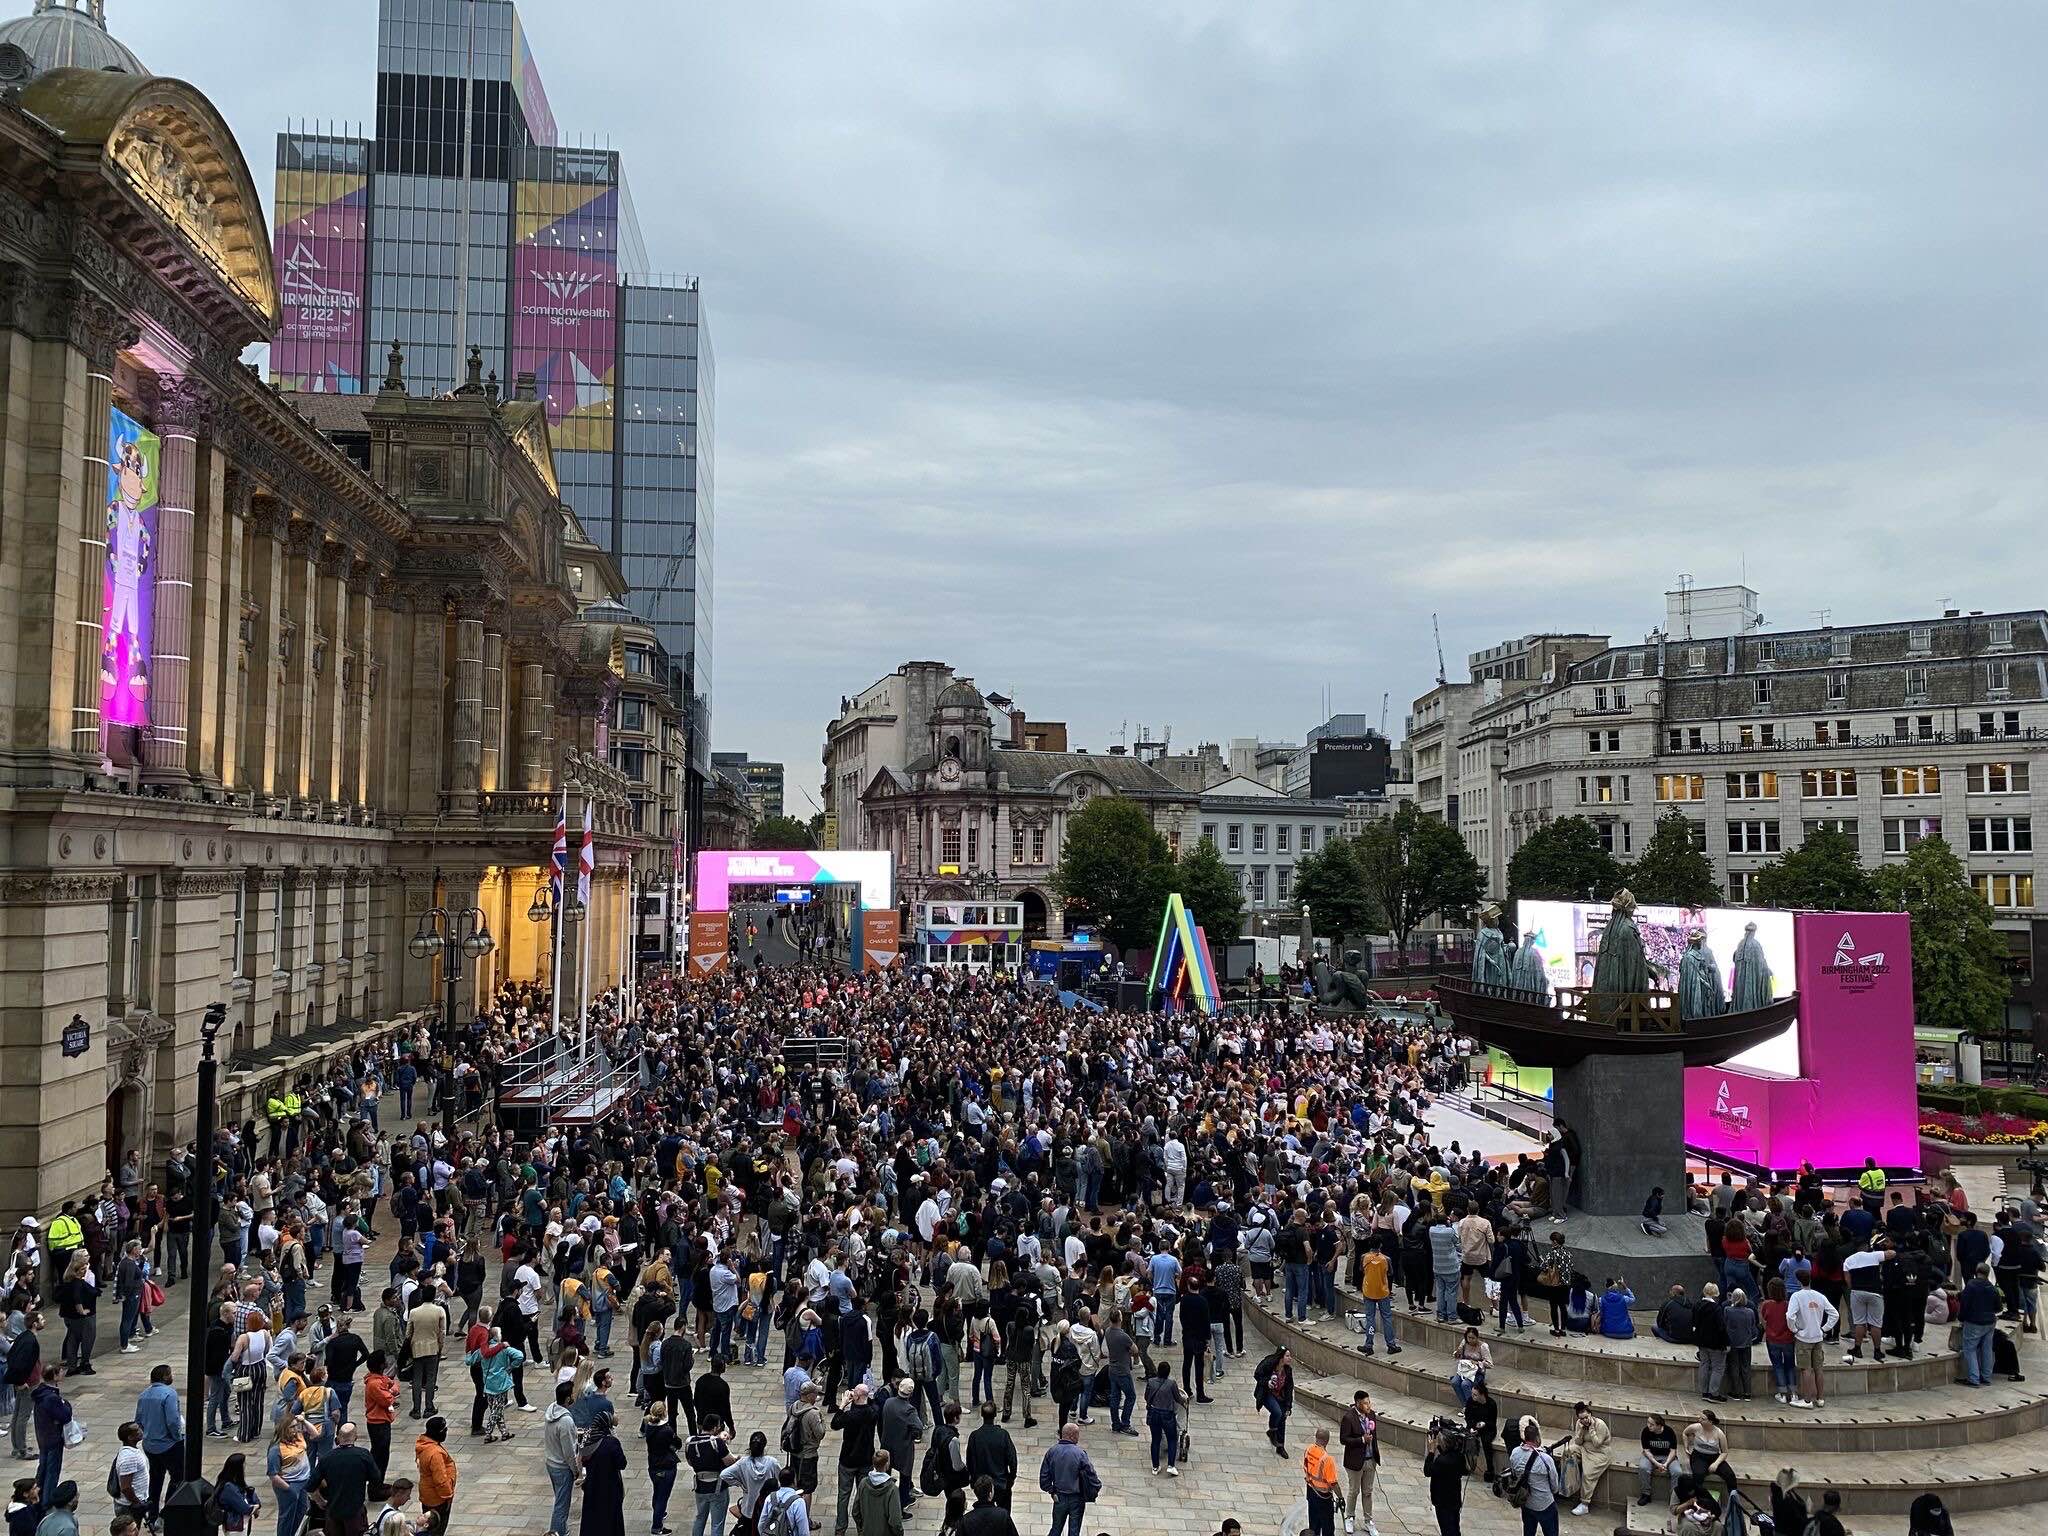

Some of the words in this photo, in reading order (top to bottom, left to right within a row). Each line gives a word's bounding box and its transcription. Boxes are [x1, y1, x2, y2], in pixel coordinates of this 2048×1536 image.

[521, 305, 610, 318] commonwealth
[550, 316, 581, 326] sport
[1324, 743, 1351, 751] Premier
[1352, 743, 1363, 751] Inn
[1821, 964, 1870, 975] BIRMINGHAM
[1871, 964, 1891, 975] 2022
[1840, 974, 1874, 983] FESTIVAL
[66, 1031, 87, 1042] VICTORIA
[69, 1038, 85, 1049] SQUARE
[1709, 1109, 1740, 1124] BIRMINGHAM
[1740, 1117, 1753, 1129] 2022
[1720, 1120, 1742, 1135] FESTIVAL
